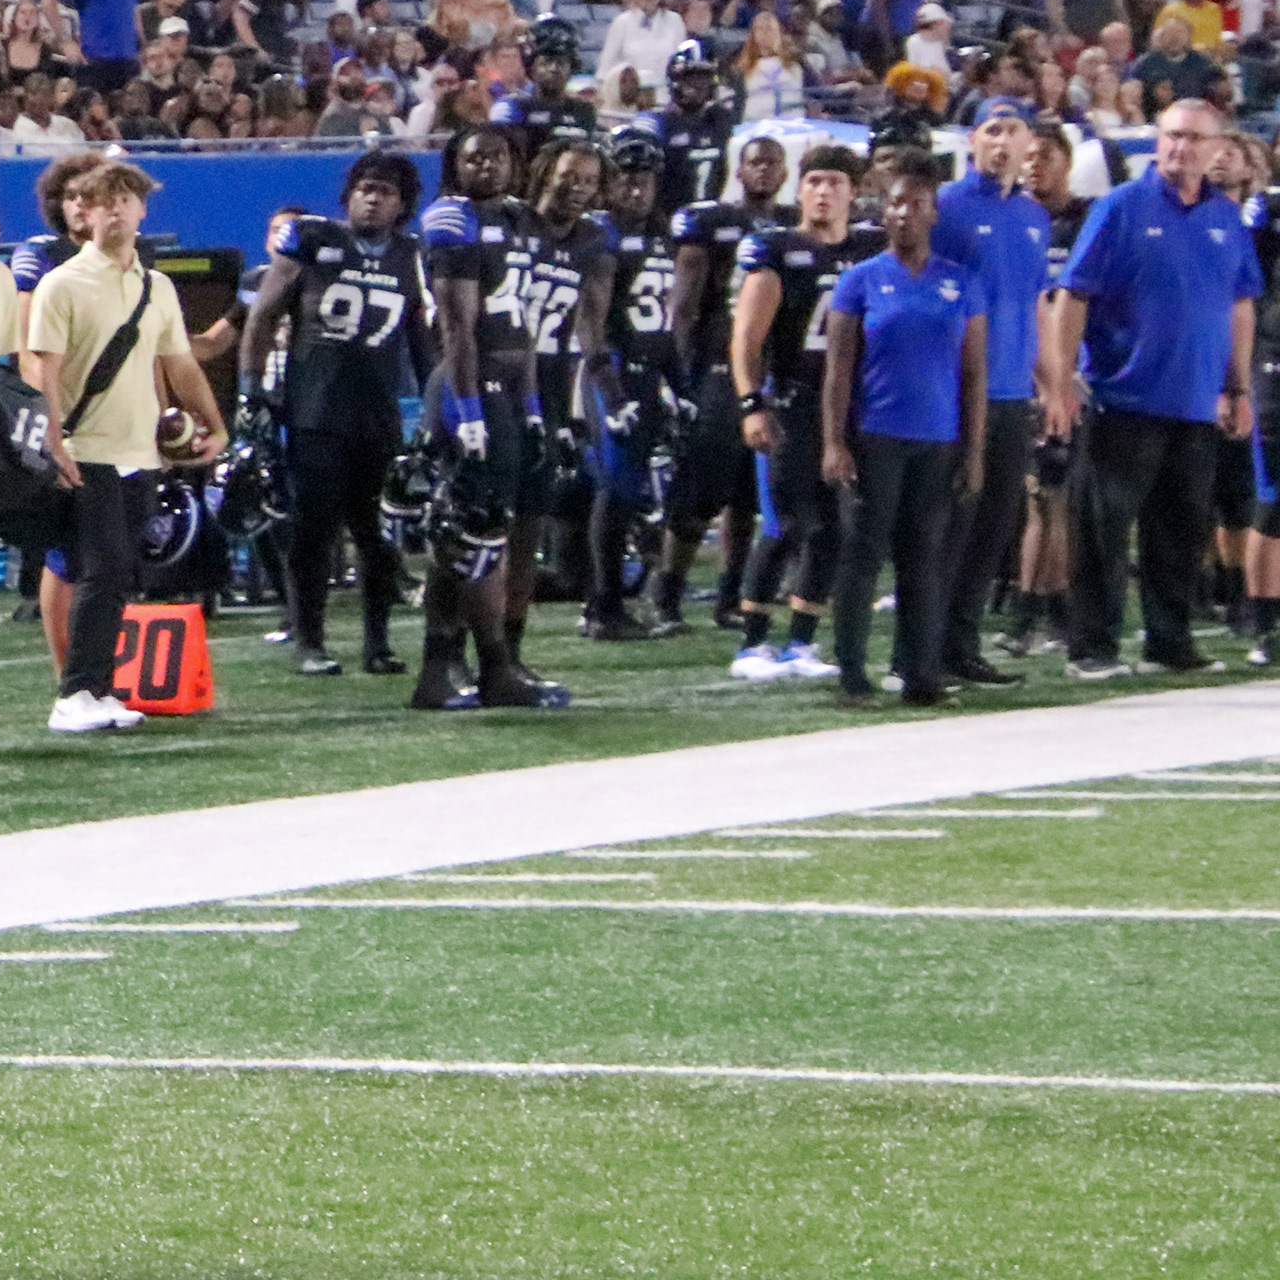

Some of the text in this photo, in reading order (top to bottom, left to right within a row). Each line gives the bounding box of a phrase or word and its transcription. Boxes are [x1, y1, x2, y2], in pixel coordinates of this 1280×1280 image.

[319, 282, 406, 347] 97
[10, 407, 49, 452] 12
[110, 618, 186, 701] 20
